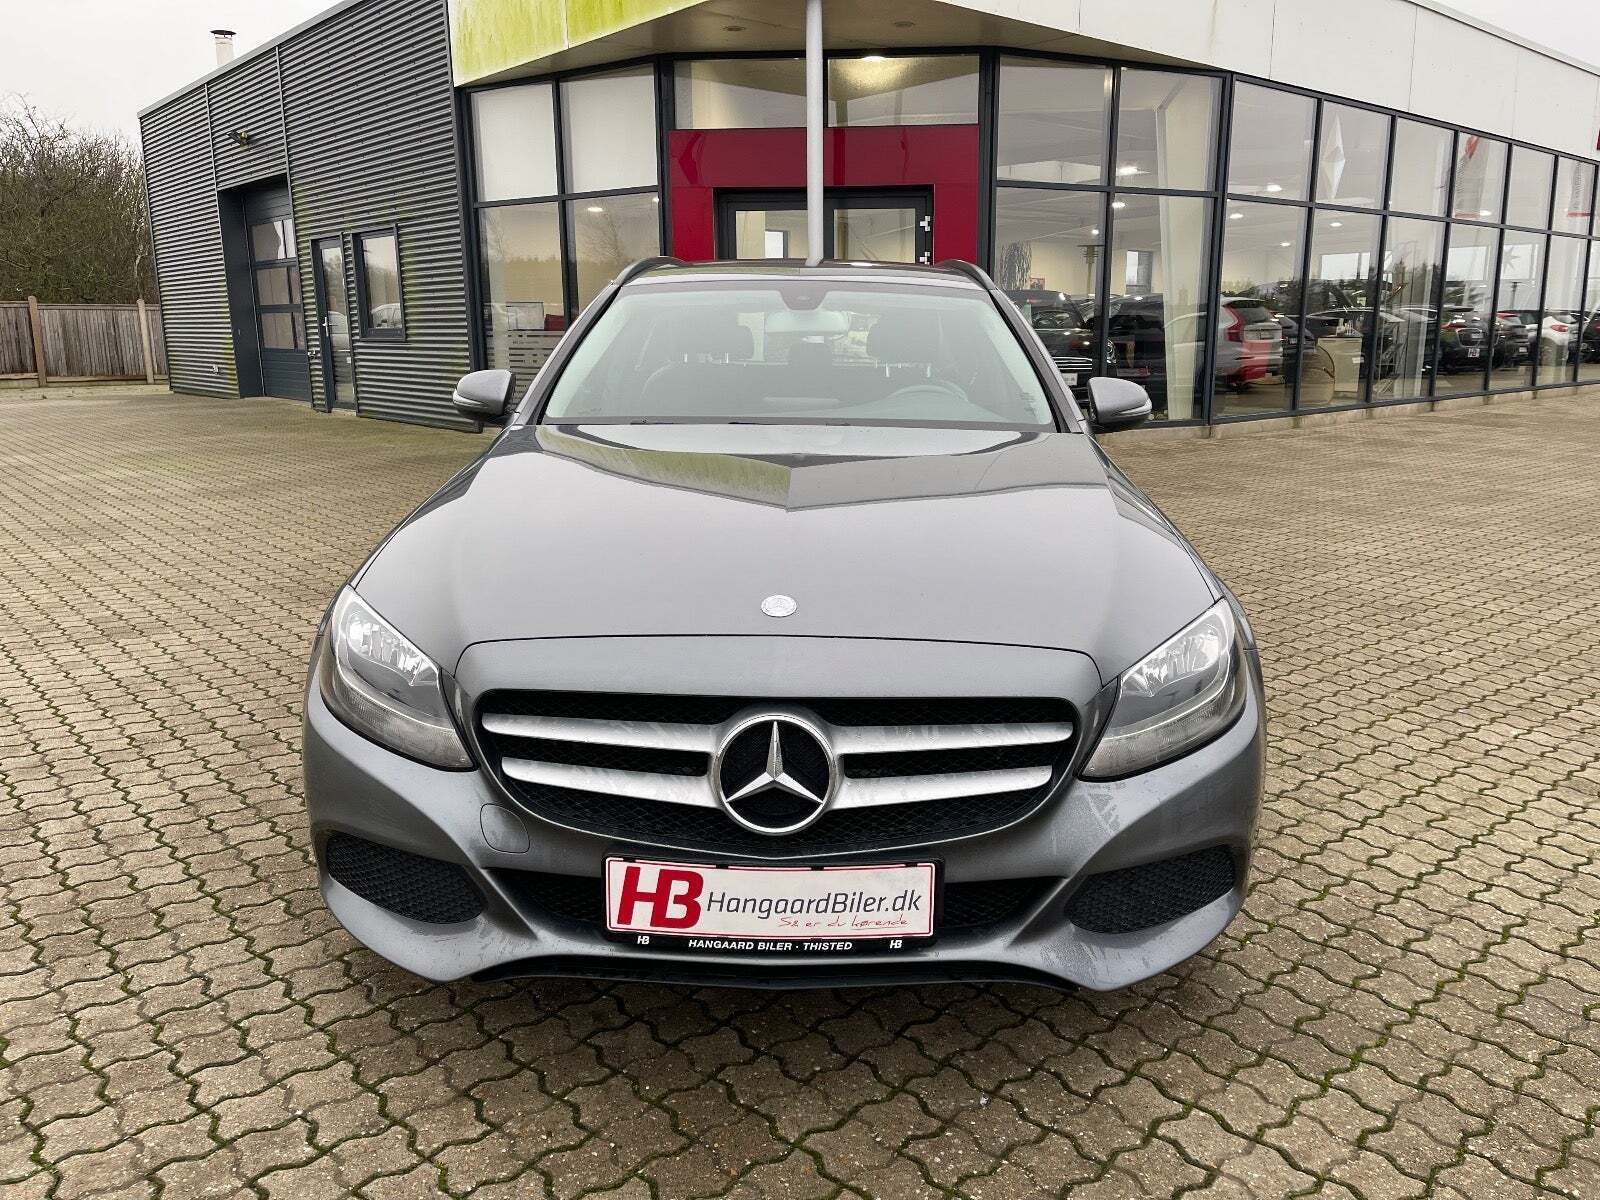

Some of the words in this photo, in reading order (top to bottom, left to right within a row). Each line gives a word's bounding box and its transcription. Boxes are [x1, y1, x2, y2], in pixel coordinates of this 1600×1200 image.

[617, 866, 704, 929] HB
[707, 889, 922, 919] HangaardBiler.dk
[637, 936, 650, 945] HB
[688, 939, 754, 950] HANGAARD
[757, 941, 792, 951] BILER
[803, 941, 852, 951] THISTED
[889, 939, 903, 949] HB
